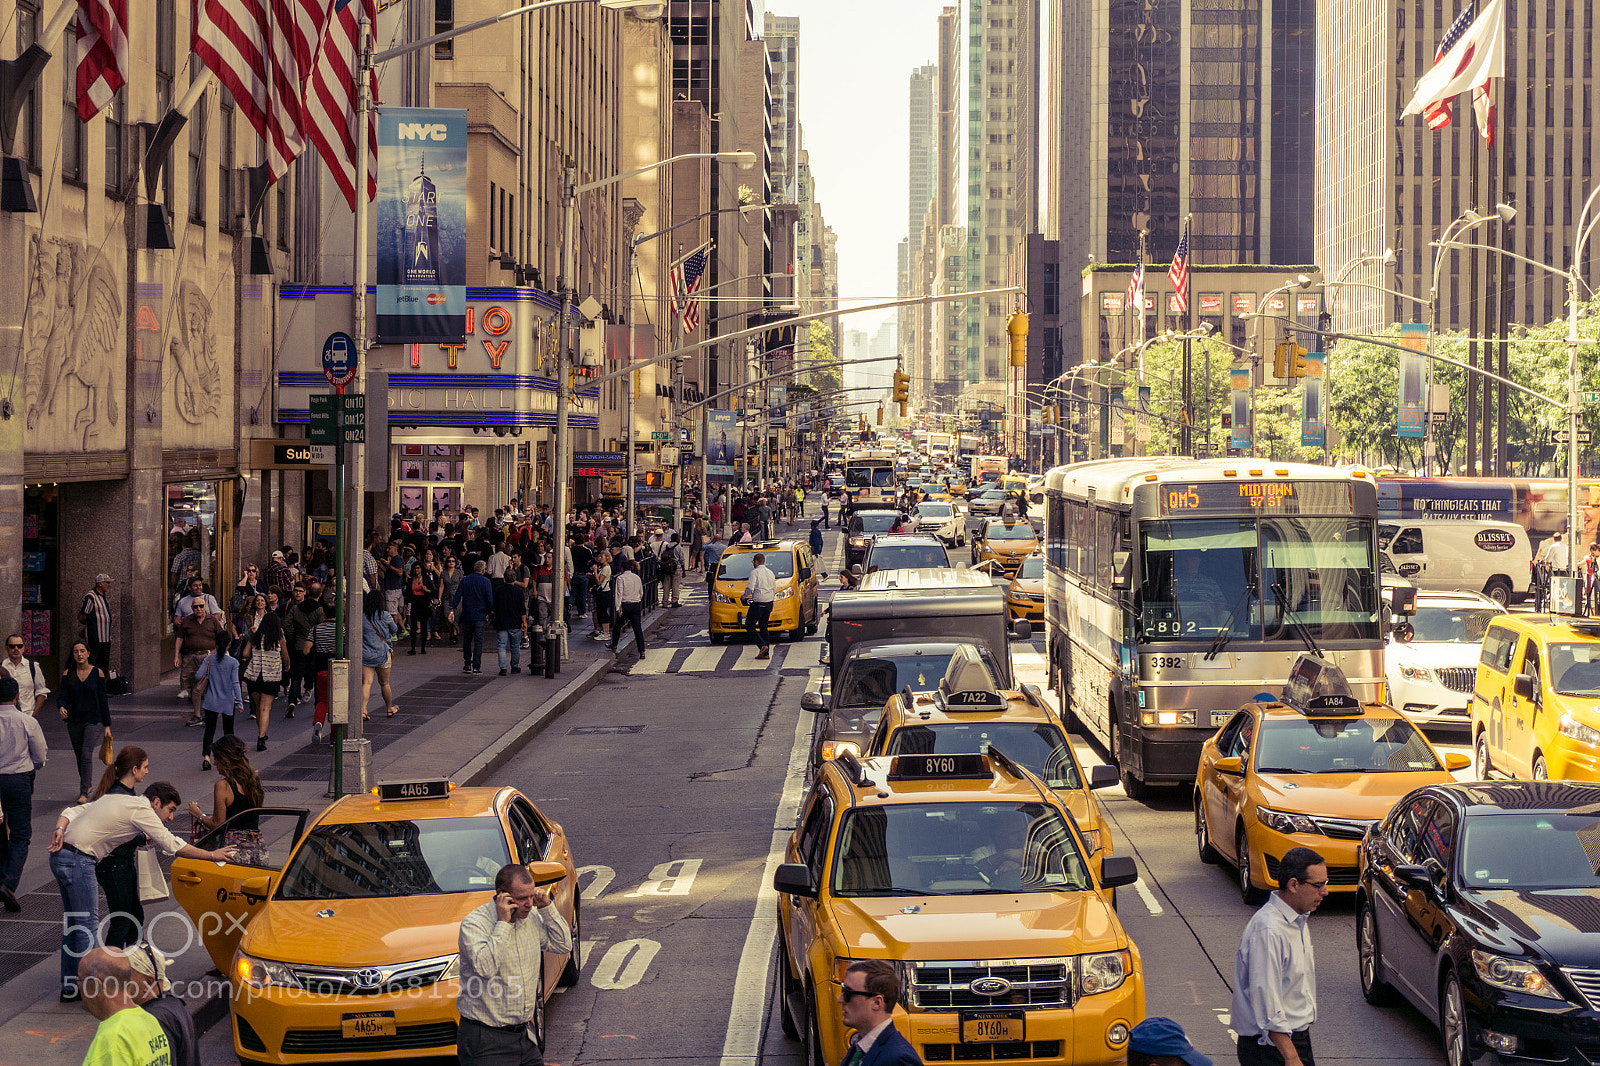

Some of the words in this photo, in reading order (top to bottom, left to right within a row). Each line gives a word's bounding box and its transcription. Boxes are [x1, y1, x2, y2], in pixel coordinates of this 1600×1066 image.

[398, 122, 447, 141] NYC
[406, 214, 434, 227] ONE
[396, 295, 419, 304] jetBlue
[410, 340, 512, 369] ITY
[325, 370, 333, 380] NO
[345, 396, 364, 409] QM10
[445, 389, 511, 409] HALL
[344, 413, 364, 425] QM12
[1400, 410, 1423, 427] 1251
[345, 429, 364, 441] QM24
[1233, 429, 1250, 441] 1251
[1303, 424, 1321, 438] 1251
[286, 448, 311, 460] Sub
[578, 467, 606, 477] NBC
[1168, 485, 1200, 508] QM5
[1239, 484, 1293, 497] MIDTOWN
[1249, 497, 1264, 507] 57
[1267, 496, 1282, 507] ST
[1480, 500, 1502, 511] THAT
[1477, 533, 1511, 542] BLISSET
[1158, 621, 1197, 633] 802
[1151, 656, 1181, 668] 3392
[962, 692, 987, 703] 7A22
[1323, 697, 1344, 706] 1A84
[926, 758, 955, 773] 8Y60
[400, 783, 429, 796] 4A65
[981, 982, 1001, 991] Ford
[917, 1027, 960, 1035] ESCAPE
[977, 1021, 1009, 1036] 8Y60H
